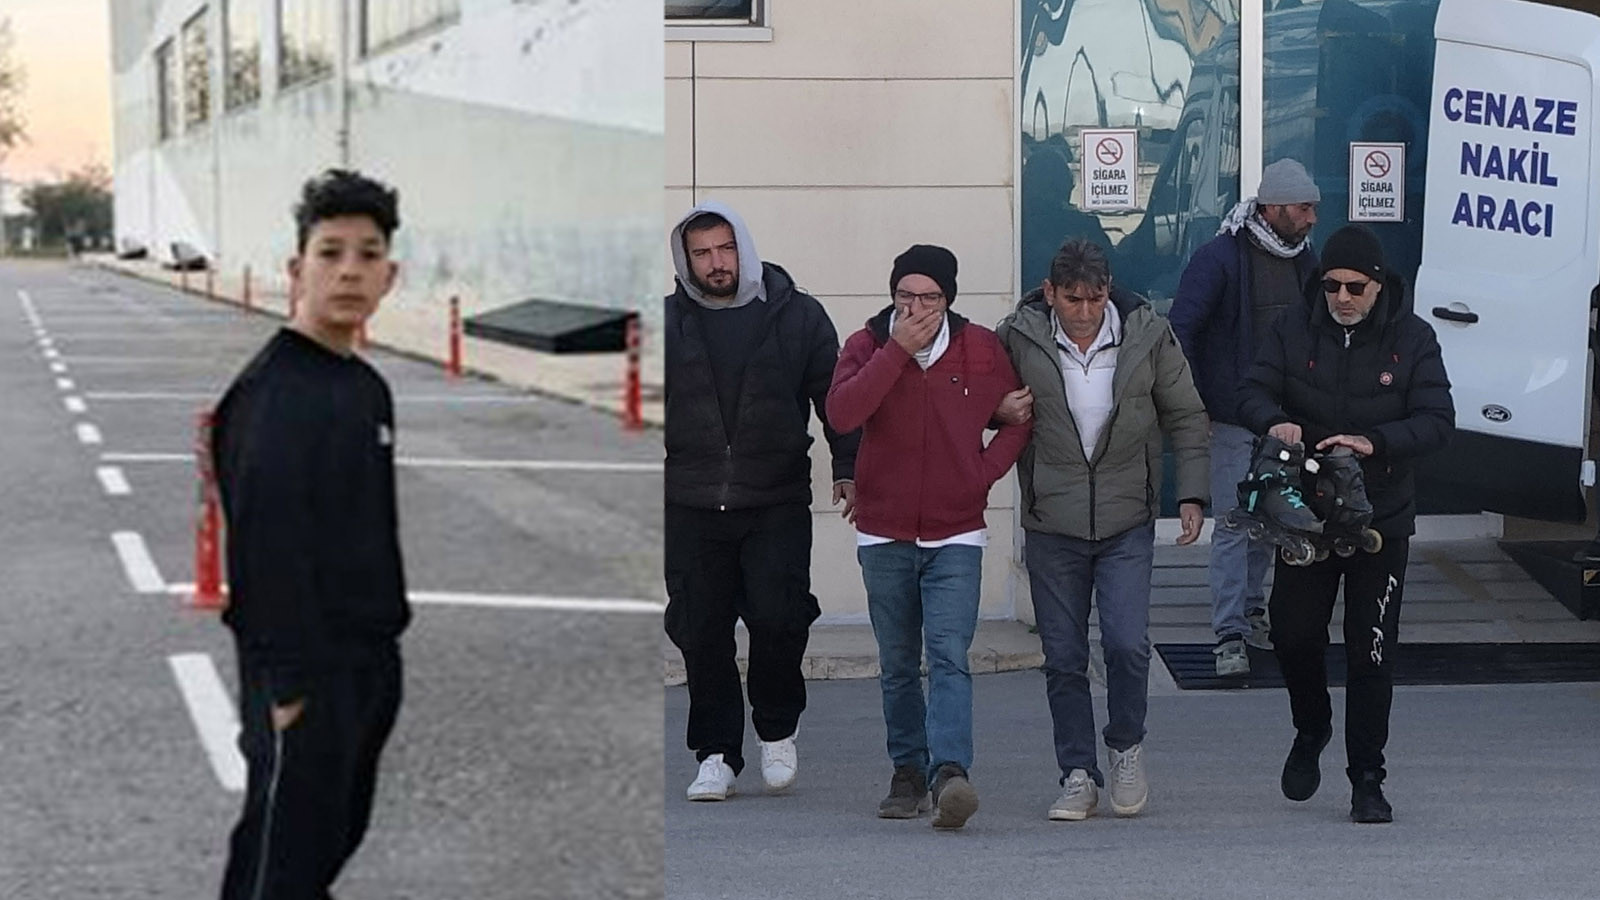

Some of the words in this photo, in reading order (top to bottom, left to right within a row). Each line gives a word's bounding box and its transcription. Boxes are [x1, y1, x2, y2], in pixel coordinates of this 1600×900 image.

[1443, 87, 1578, 136] CENAZE
[1460, 141, 1558, 187] NAKİL
[1092, 166, 1127, 180] SİGARA
[1091, 182, 1129, 198] İÇİLMEZ
[1360, 179, 1394, 193] SİGARA
[1358, 194, 1396, 210] İÇİLMEZ
[1451, 192, 1553, 237] ARACI
